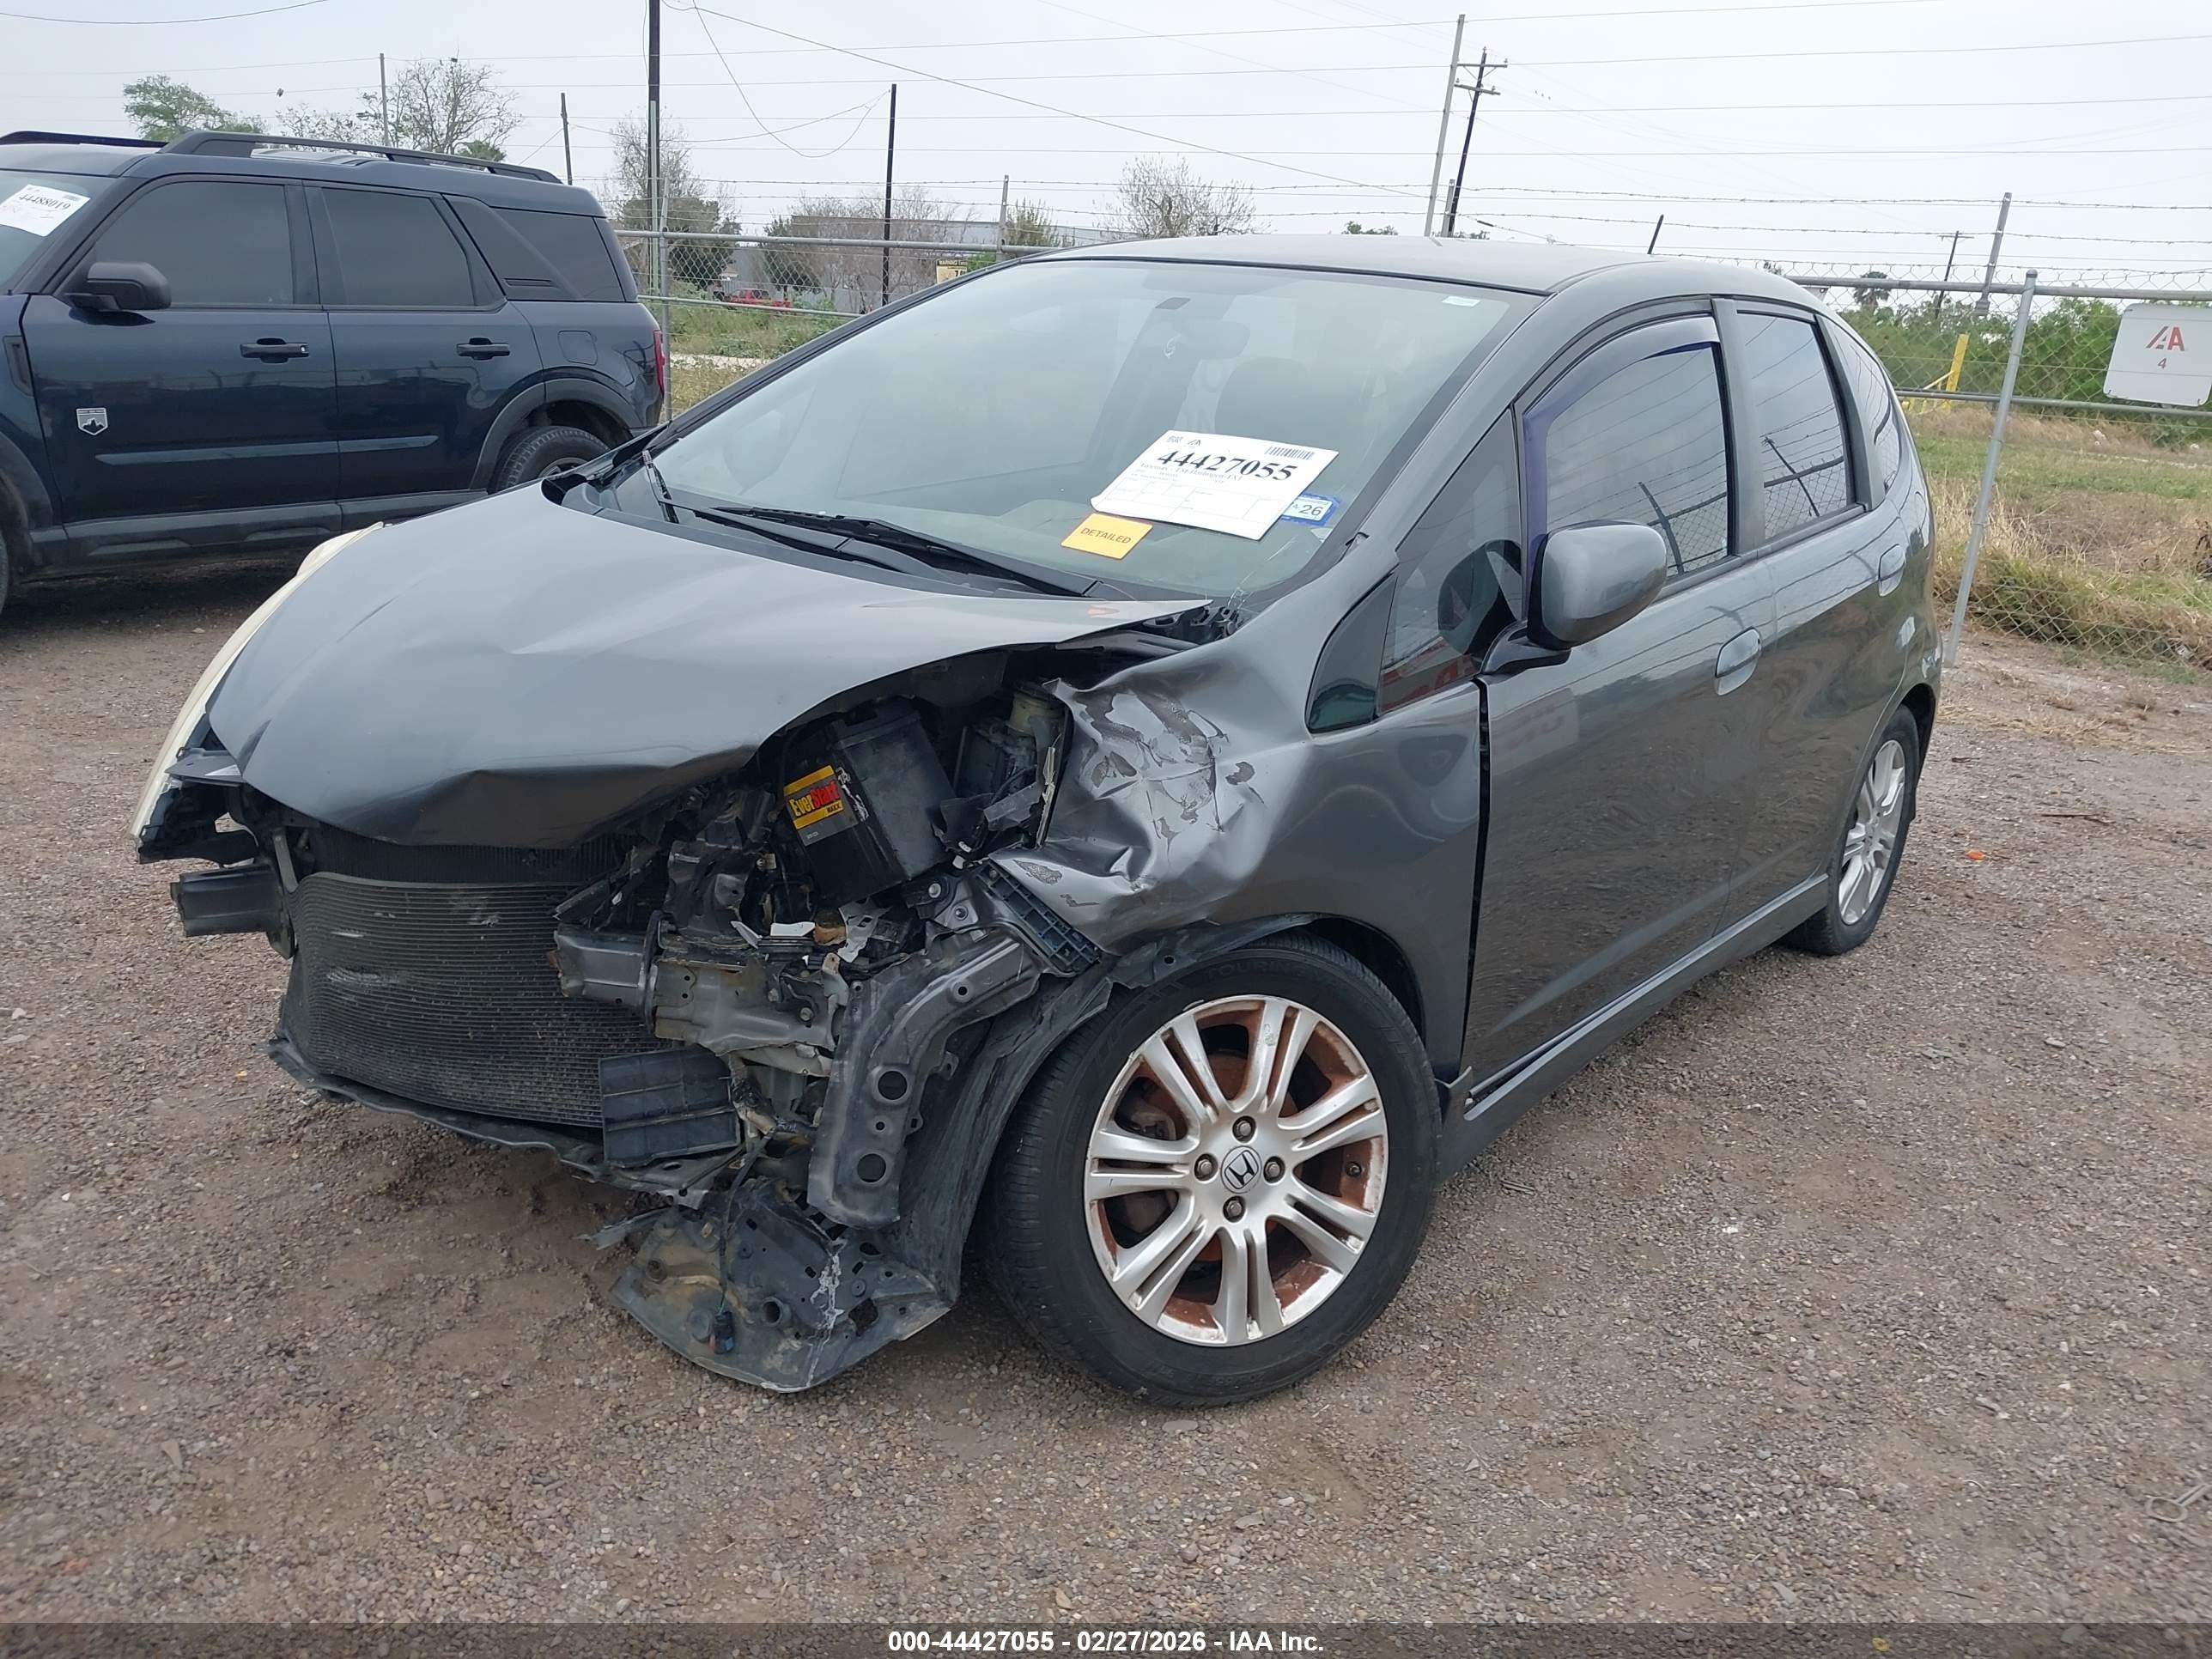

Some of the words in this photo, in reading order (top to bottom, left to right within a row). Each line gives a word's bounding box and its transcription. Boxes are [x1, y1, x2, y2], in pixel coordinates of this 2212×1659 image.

[2157, 357, 2167, 369] 4
[1157, 450, 1298, 481] 44427055
[1298, 504, 1324, 516] 26
[1080, 527, 1132, 544] DETAILED
[789, 780, 840, 817] EverStart
